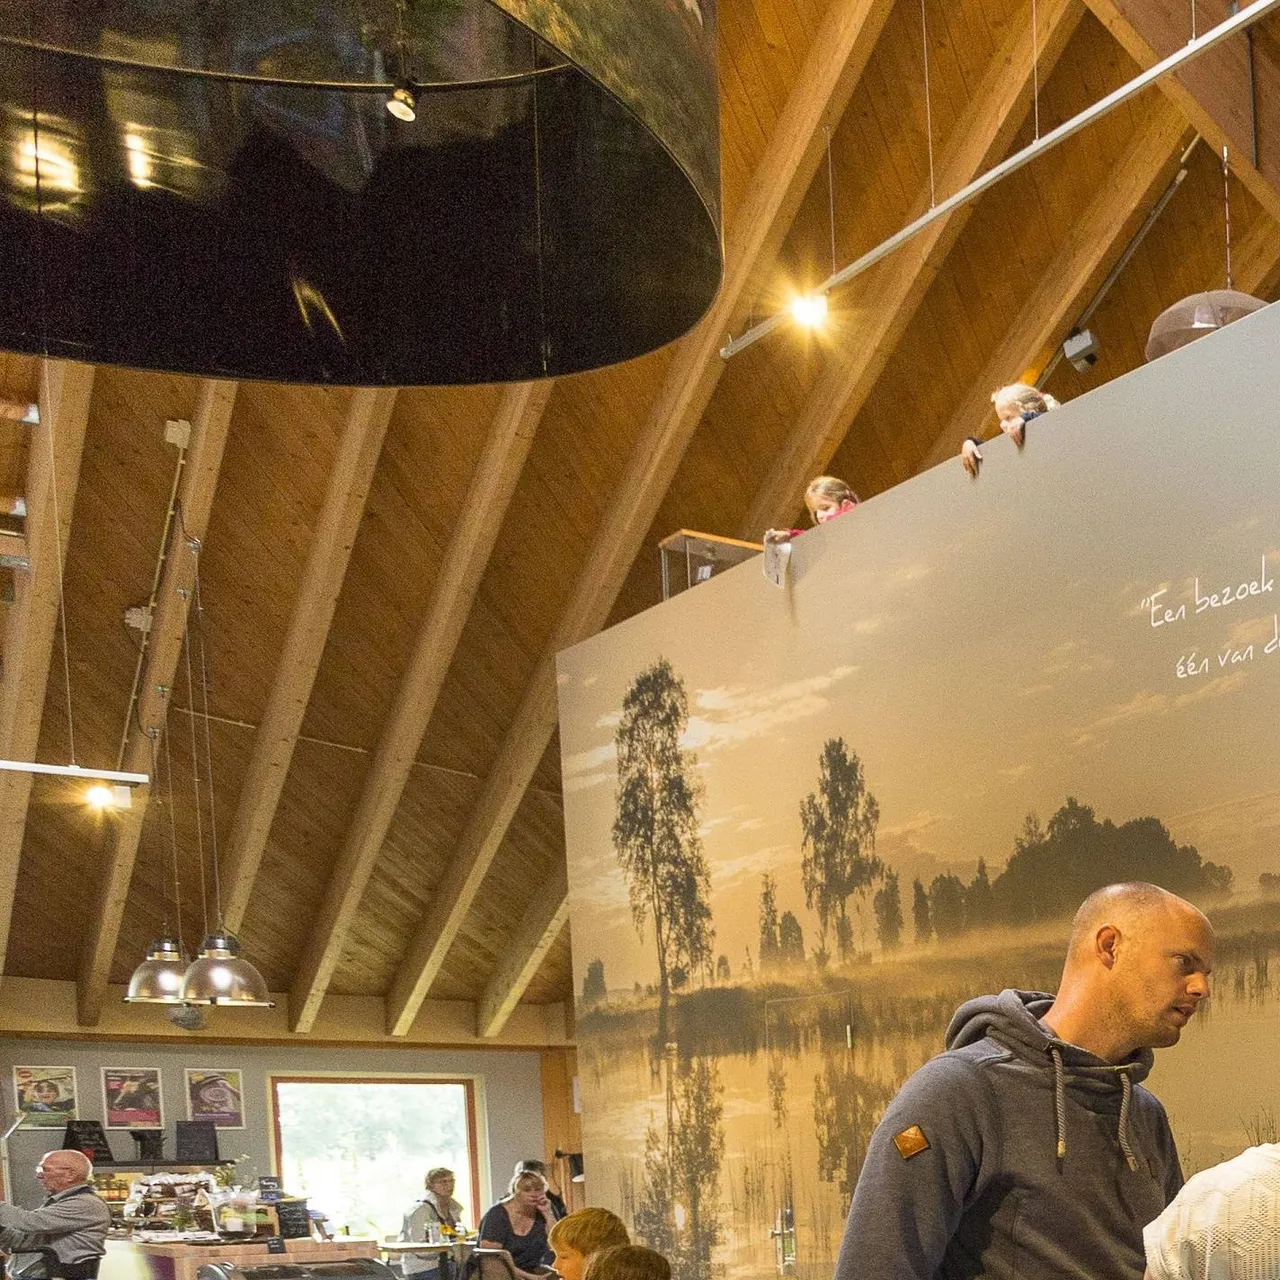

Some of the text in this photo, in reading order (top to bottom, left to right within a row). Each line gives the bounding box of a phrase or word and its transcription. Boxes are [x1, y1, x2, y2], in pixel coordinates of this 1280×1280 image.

[1194, 553, 1274, 614] bezoek
[1175, 651, 1210, 679] één
[1218, 644, 1254, 668] van
